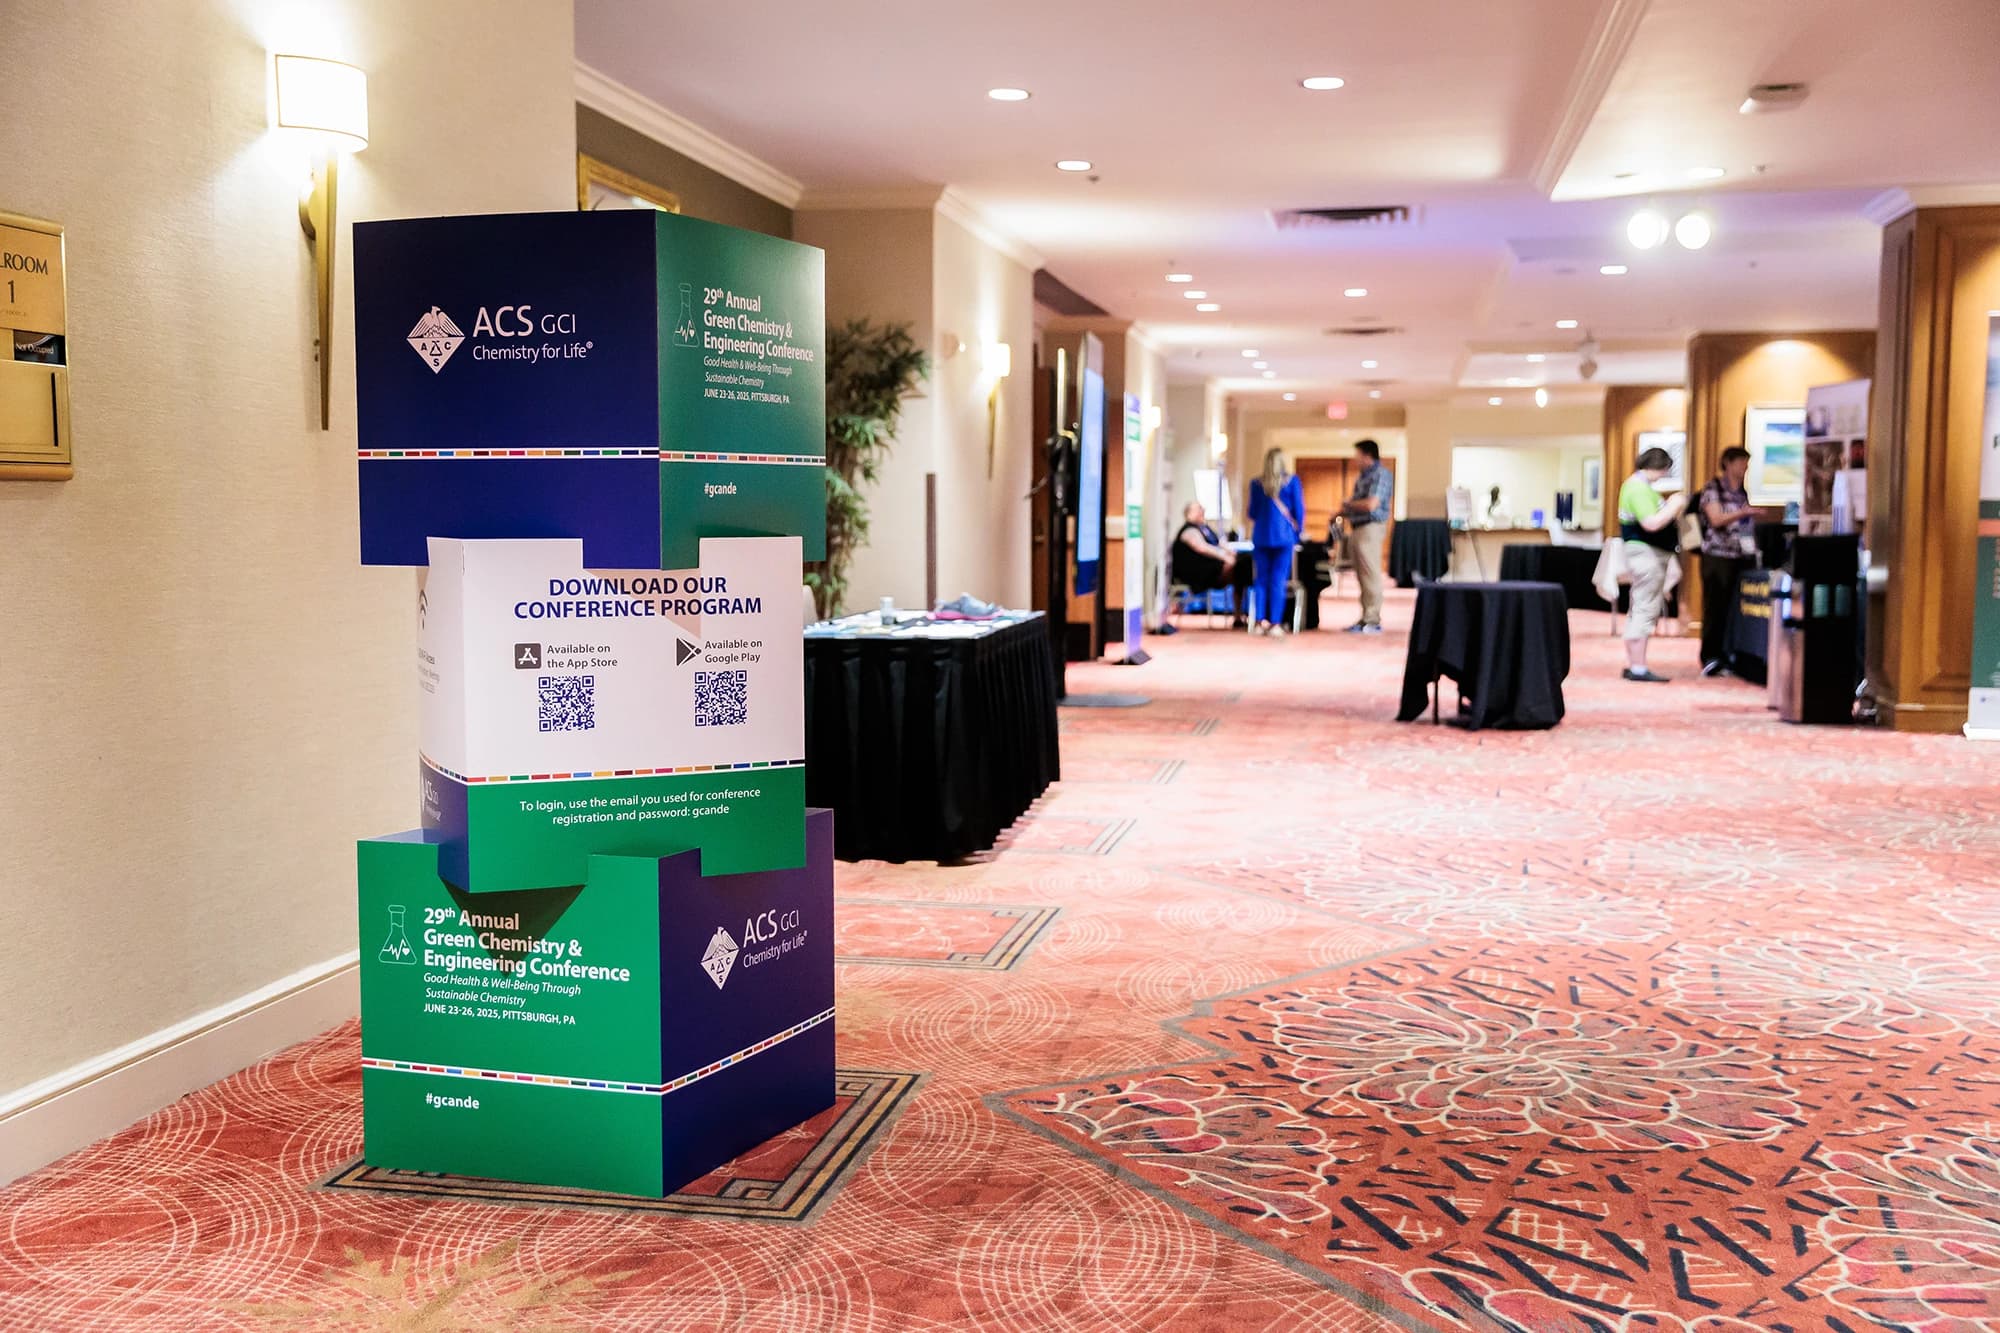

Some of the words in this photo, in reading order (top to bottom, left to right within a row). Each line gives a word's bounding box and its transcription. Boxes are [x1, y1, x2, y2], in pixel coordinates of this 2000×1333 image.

[0, 252, 48, 275] ROOM
[8, 280, 14, 303] 1
[704, 288, 724, 304] 29th
[726, 291, 760, 312] Annual
[473, 306, 534, 337] ACS
[541, 315, 575, 334] GCI
[704, 309, 735, 329] Green
[738, 314, 784, 340] Chemistry
[786, 322, 792, 338] &
[421, 343, 427, 351] A
[445, 342, 451, 350] C
[473, 344, 539, 363] Chemistry
[542, 343, 560, 359] for
[704, 331, 764, 360] Engineering
[766, 340, 813, 361] Conference
[434, 358, 439, 366] S
[704, 356, 720, 366] Good
[721, 358, 739, 369] Health
[740, 360, 743, 370] &
[745, 361, 771, 375] Well-Being
[706, 372, 738, 384] Sustainable
[739, 375, 764, 389] Chemistry
[704, 388, 718, 398] JUNE
[783, 395, 790, 403] PA
[704, 482, 736, 497] #gcande
[550, 578, 677, 596] DOWNLOAD
[684, 577, 727, 593] OUR
[514, 600, 655, 618] CONFERENCE
[661, 598, 761, 616] PROGRAM
[547, 644, 594, 654] Available
[705, 640, 748, 649] Available
[547, 658, 564, 668] the
[567, 658, 587, 670] App
[590, 657, 618, 666] Store
[705, 654, 739, 665] Google
[742, 653, 760, 663] Play
[520, 801, 533, 811] To
[537, 799, 566, 812] login,
[569, 800, 587, 808] use
[590, 796, 607, 807] the
[610, 795, 638, 806] email
[641, 796, 660, 807] you
[663, 792, 687, 803] used
[689, 790, 703, 801] for
[706, 788, 760, 800] conference
[553, 813, 613, 826] registration
[616, 810, 636, 821] and
[639, 808, 690, 821] password:
[693, 805, 729, 818] gcande
[424, 908, 455, 924] 29th
[459, 911, 519, 930] Annual
[743, 909, 778, 948] ACS
[781, 910, 799, 931] GCI
[424, 929, 475, 948] Green
[479, 933, 565, 958] Chemistry
[569, 939, 582, 956] &
[743, 940, 781, 967] Chemistry
[782, 939, 791, 953] for
[424, 950, 526, 976] Engineering
[530, 958, 630, 981] Conference
[726, 957, 731, 965] C
[424, 973, 448, 984] Good
[450, 975, 480, 986] Health
[482, 978, 489, 987] &
[491, 978, 539, 994] Well-Being
[542, 982, 581, 995] Through
[426, 988, 478, 1001] Sustainable
[480, 992, 526, 1007] Chemistry
[424, 1003, 446, 1014] JUNE
[448, 1005, 474, 1017] 23-26,
[477, 1008, 500, 1020] 2025,
[503, 1010, 561, 1025] PITTSBURGH,
[563, 1016, 575, 1024] PA
[426, 1093, 479, 1109] #gcande
